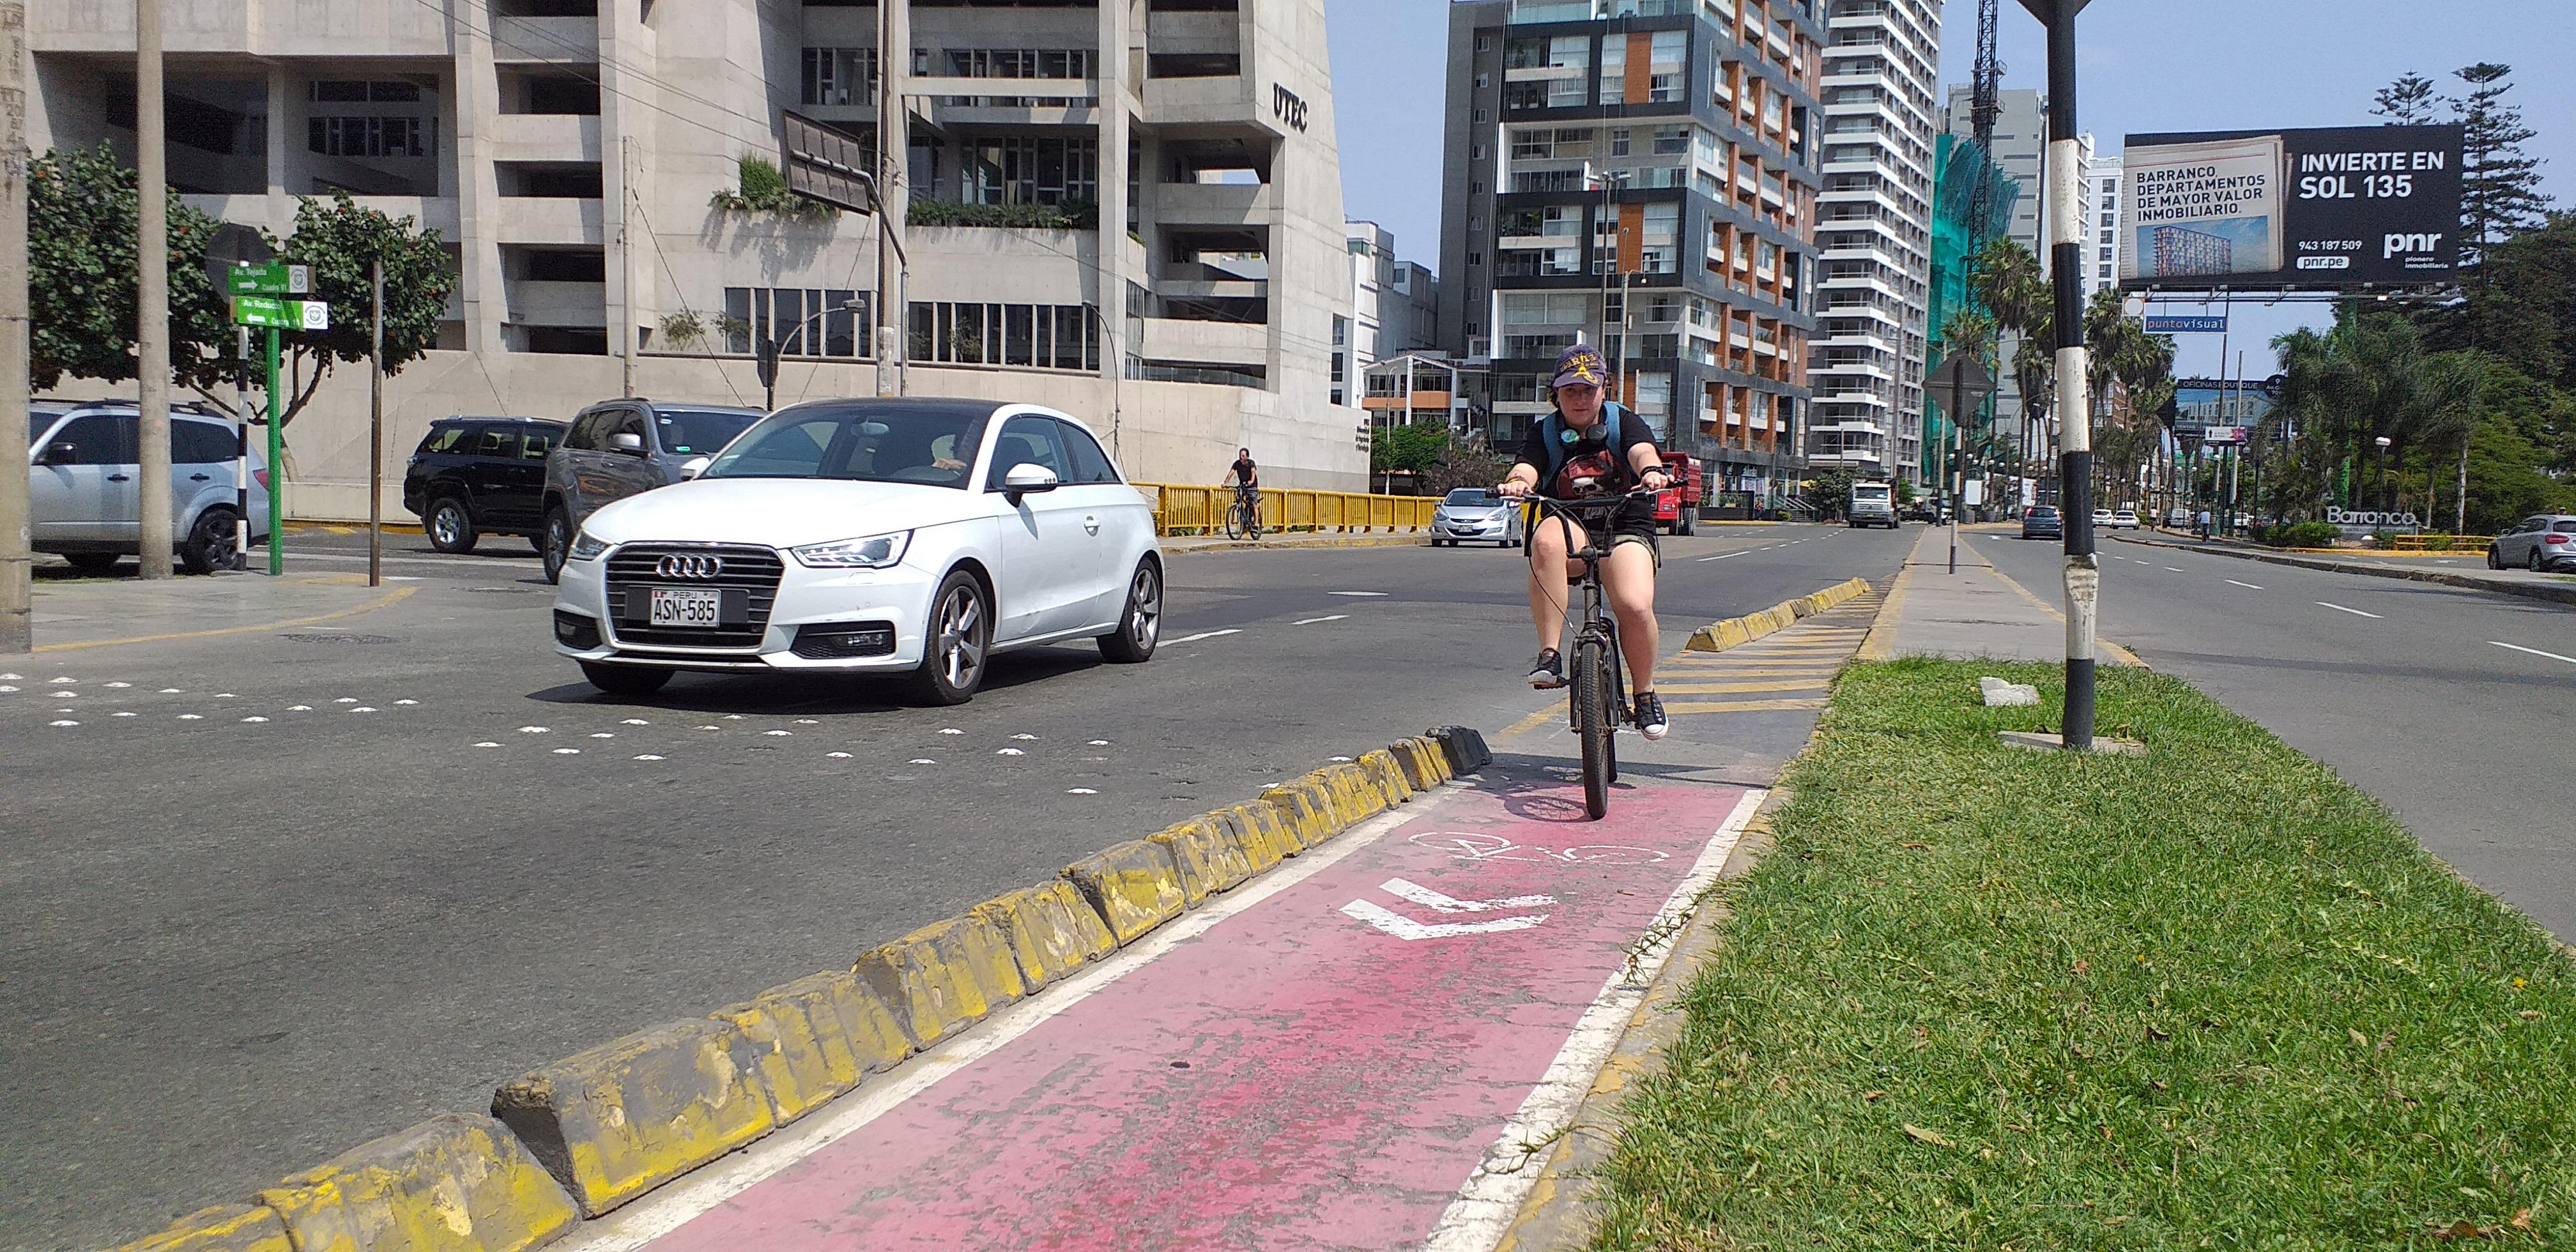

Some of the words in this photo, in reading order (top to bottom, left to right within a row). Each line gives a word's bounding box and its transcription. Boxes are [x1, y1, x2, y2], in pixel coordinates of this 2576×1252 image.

[1273, 82, 1307, 134] UTEC
[2301, 152, 2406, 172] INVIERTE
[2412, 151, 2444, 170] EN
[2136, 166, 2218, 183] BARRANCO,
[2137, 174, 2266, 196] DEPARTAMENTOS
[2299, 176, 2355, 199] SOL
[2363, 174, 2412, 197] 135
[2138, 197, 2156, 209] DE
[2160, 193, 2211, 207] MAYOR
[2214, 188, 2263, 202] VALOR
[2138, 203, 2242, 222] INMOBILIARIO.
[2299, 241, 2318, 250] 943
[2320, 241, 2340, 250] 187
[2342, 240, 2362, 250] 509
[2384, 233, 2442, 259] pnr
[2303, 257, 2343, 269] pnr.pe
[2148, 319, 2224, 329] puntovisual
[2327, 506, 2416, 526] Barranco
[654, 599, 716, 622] ASN-585
